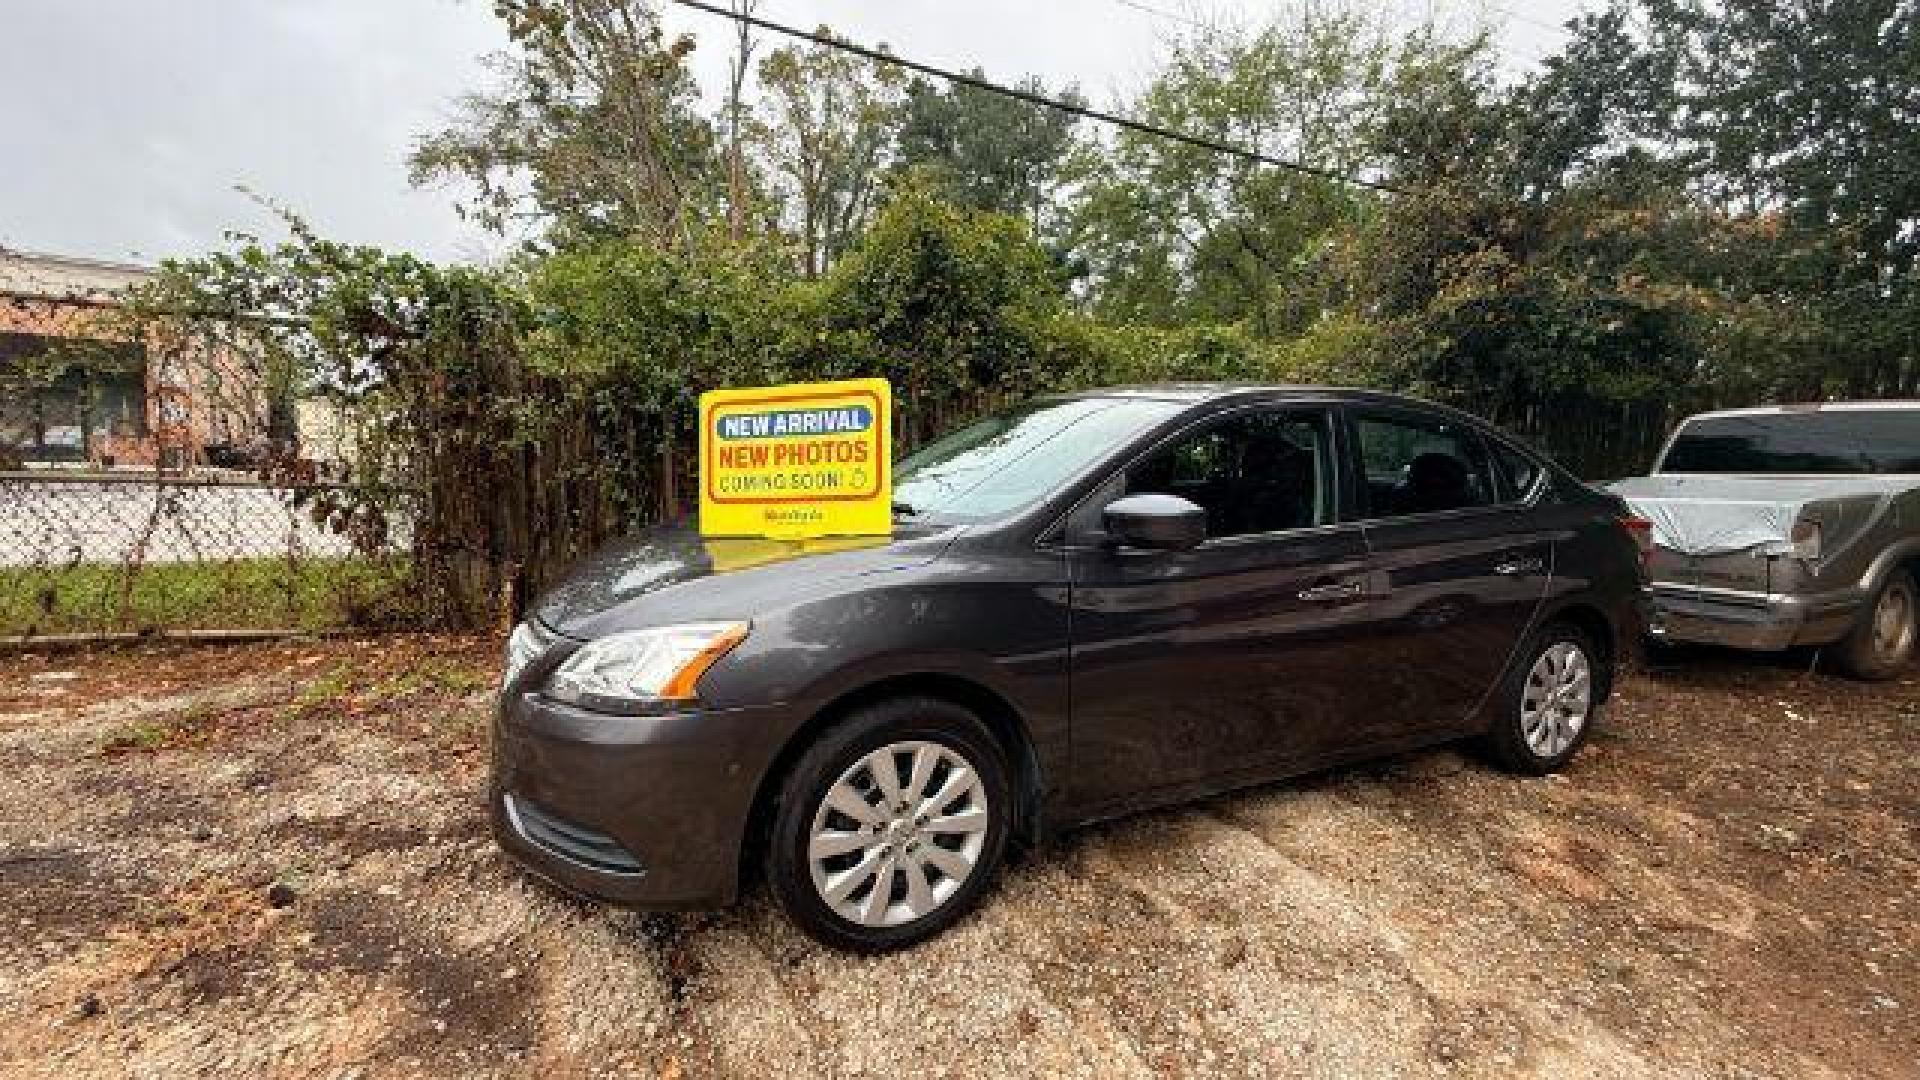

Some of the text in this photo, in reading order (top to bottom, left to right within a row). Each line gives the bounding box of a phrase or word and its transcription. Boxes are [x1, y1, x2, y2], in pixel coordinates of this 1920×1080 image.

[725, 410, 863, 436] NEW ARRIVAL
[719, 440, 868, 469] NEW PHOTOS
[719, 474, 787, 493] COMING
